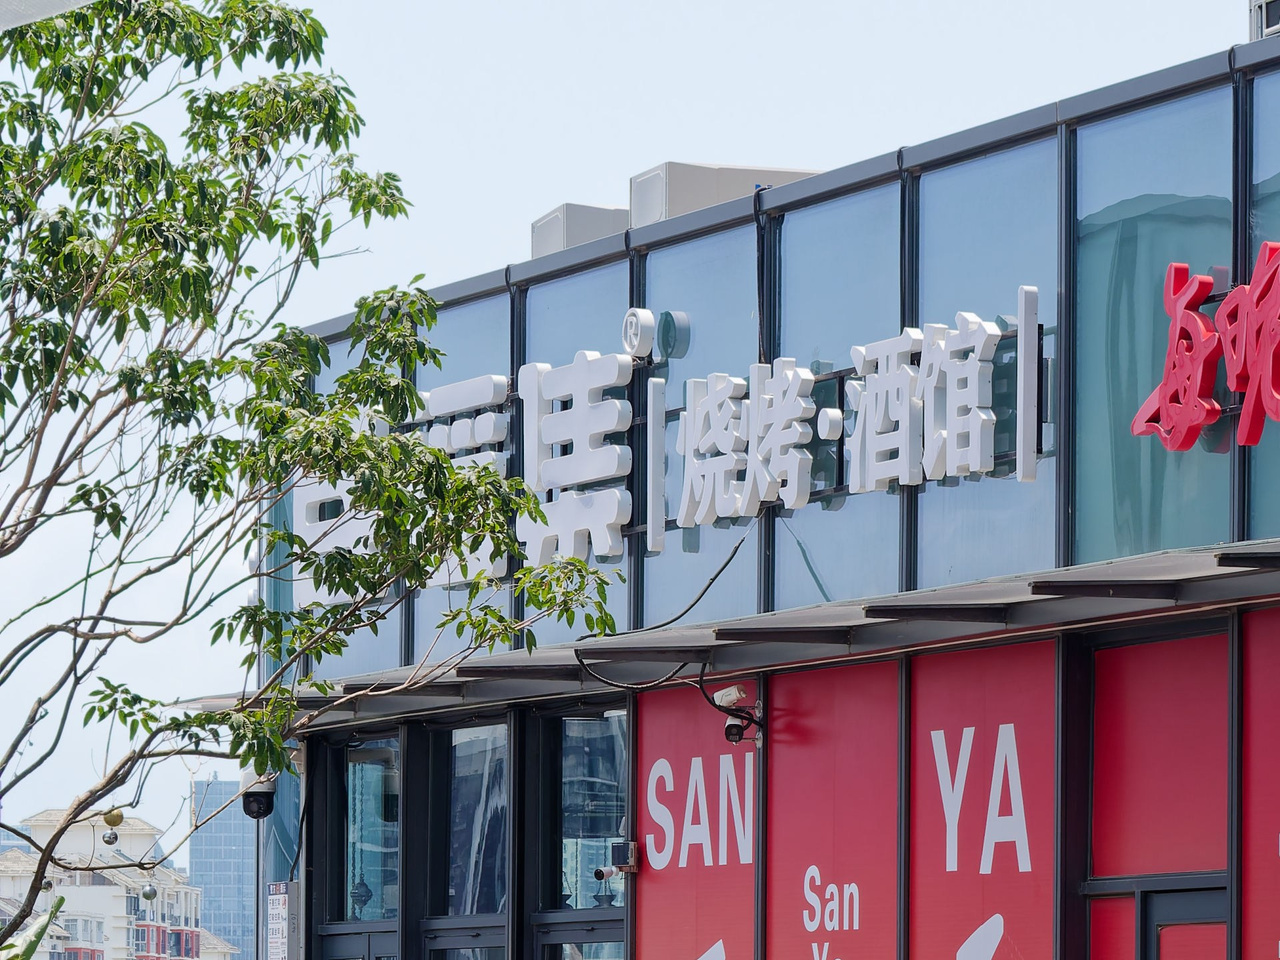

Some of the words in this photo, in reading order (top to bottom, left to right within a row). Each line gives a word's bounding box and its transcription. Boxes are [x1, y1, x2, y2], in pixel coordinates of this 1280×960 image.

[646, 752, 754, 870] SAN
[931, 723, 1032, 875] YA
[802, 864, 860, 933] San
